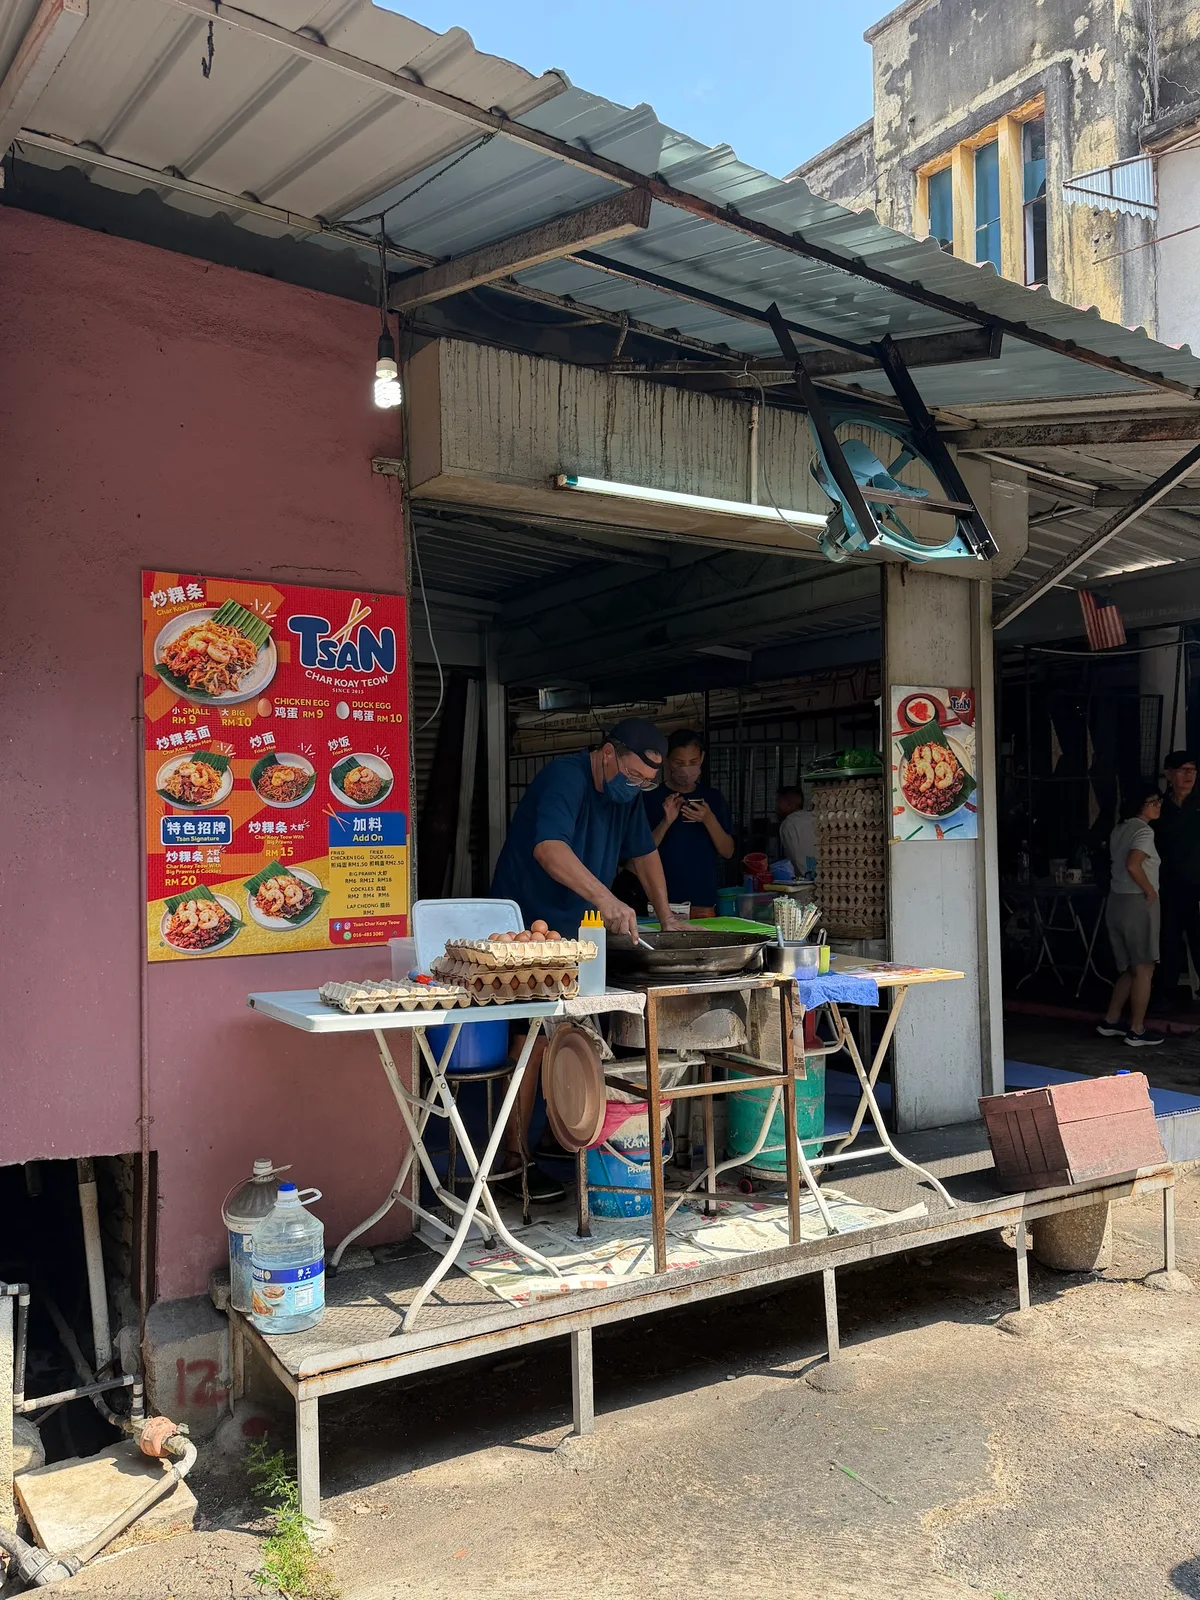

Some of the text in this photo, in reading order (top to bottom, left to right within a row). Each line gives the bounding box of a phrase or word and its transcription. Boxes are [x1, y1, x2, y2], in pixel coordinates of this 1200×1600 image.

[150, 583, 204, 608] 炒粿条
[173, 604, 189, 613] Koay
[305, 670, 388, 687] CHAR KOAY TEOW
[274, 697, 312, 706] CHICKEN
[172, 706, 210, 715] 小 SMALL
[221, 708, 229, 716] 大
[275, 707, 298, 719] 鸡蛋
[316, 709, 324, 718] 9
[353, 710, 374, 722] 鸭蛋
[390, 714, 403, 723] 10
[189, 715, 197, 724] 9
[237, 717, 252, 727] 10
[156, 725, 211, 750] 炒粿条面
[249, 732, 275, 748] 炒面
[327, 736, 350, 751] 炒饭
[167, 821, 226, 835] 特色招牌
[248, 821, 287, 833] 炒粿条
[353, 817, 382, 832] 加料
[166, 851, 203, 862] 炒粿条
[280, 847, 294, 856] 15
[181, 875, 197, 885] 20
[176, 1358, 227, 1408] 12
